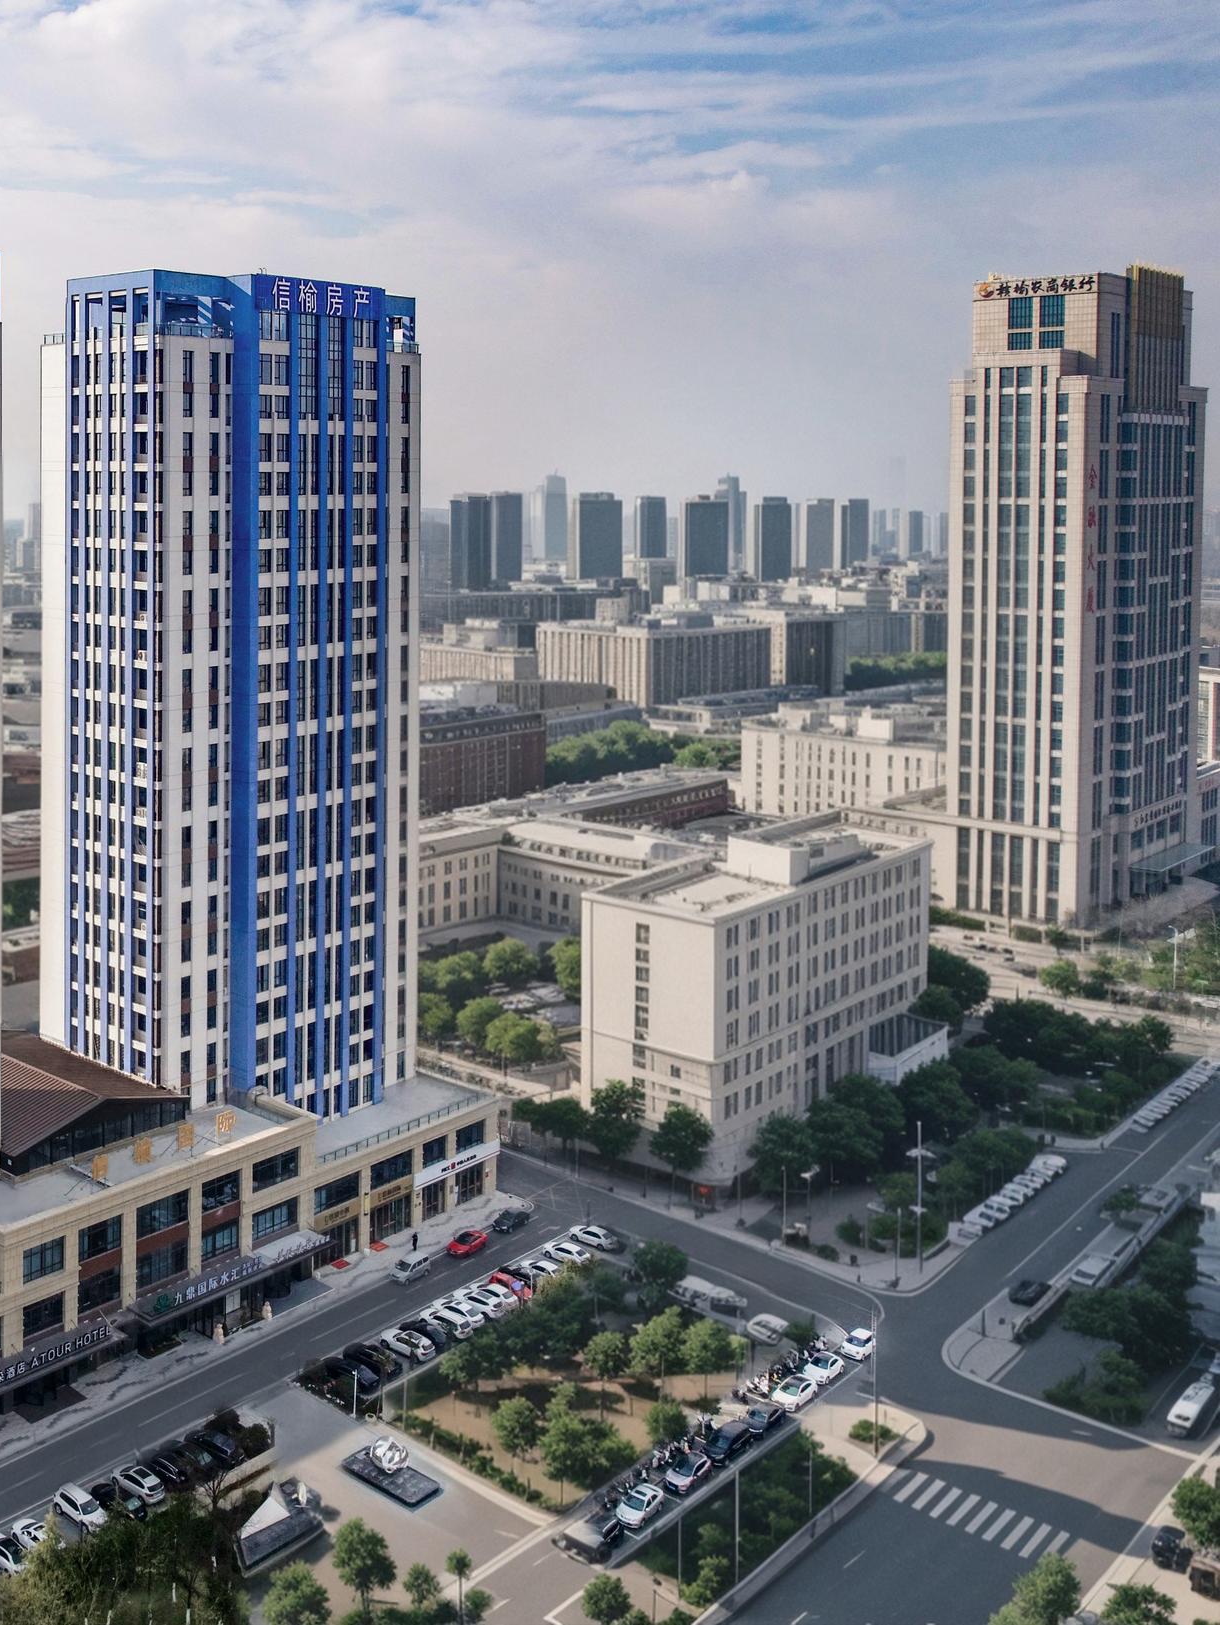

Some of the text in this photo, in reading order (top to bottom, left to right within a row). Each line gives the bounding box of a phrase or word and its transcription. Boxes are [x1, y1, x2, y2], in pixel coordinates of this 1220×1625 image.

[272, 276, 370, 318] 信榆房产
[174, 1267, 241, 1306] 九鼎国际水汇
[31, 1342, 72, 1369] ATOUR
[75, 1325, 112, 1349] HOTEL
